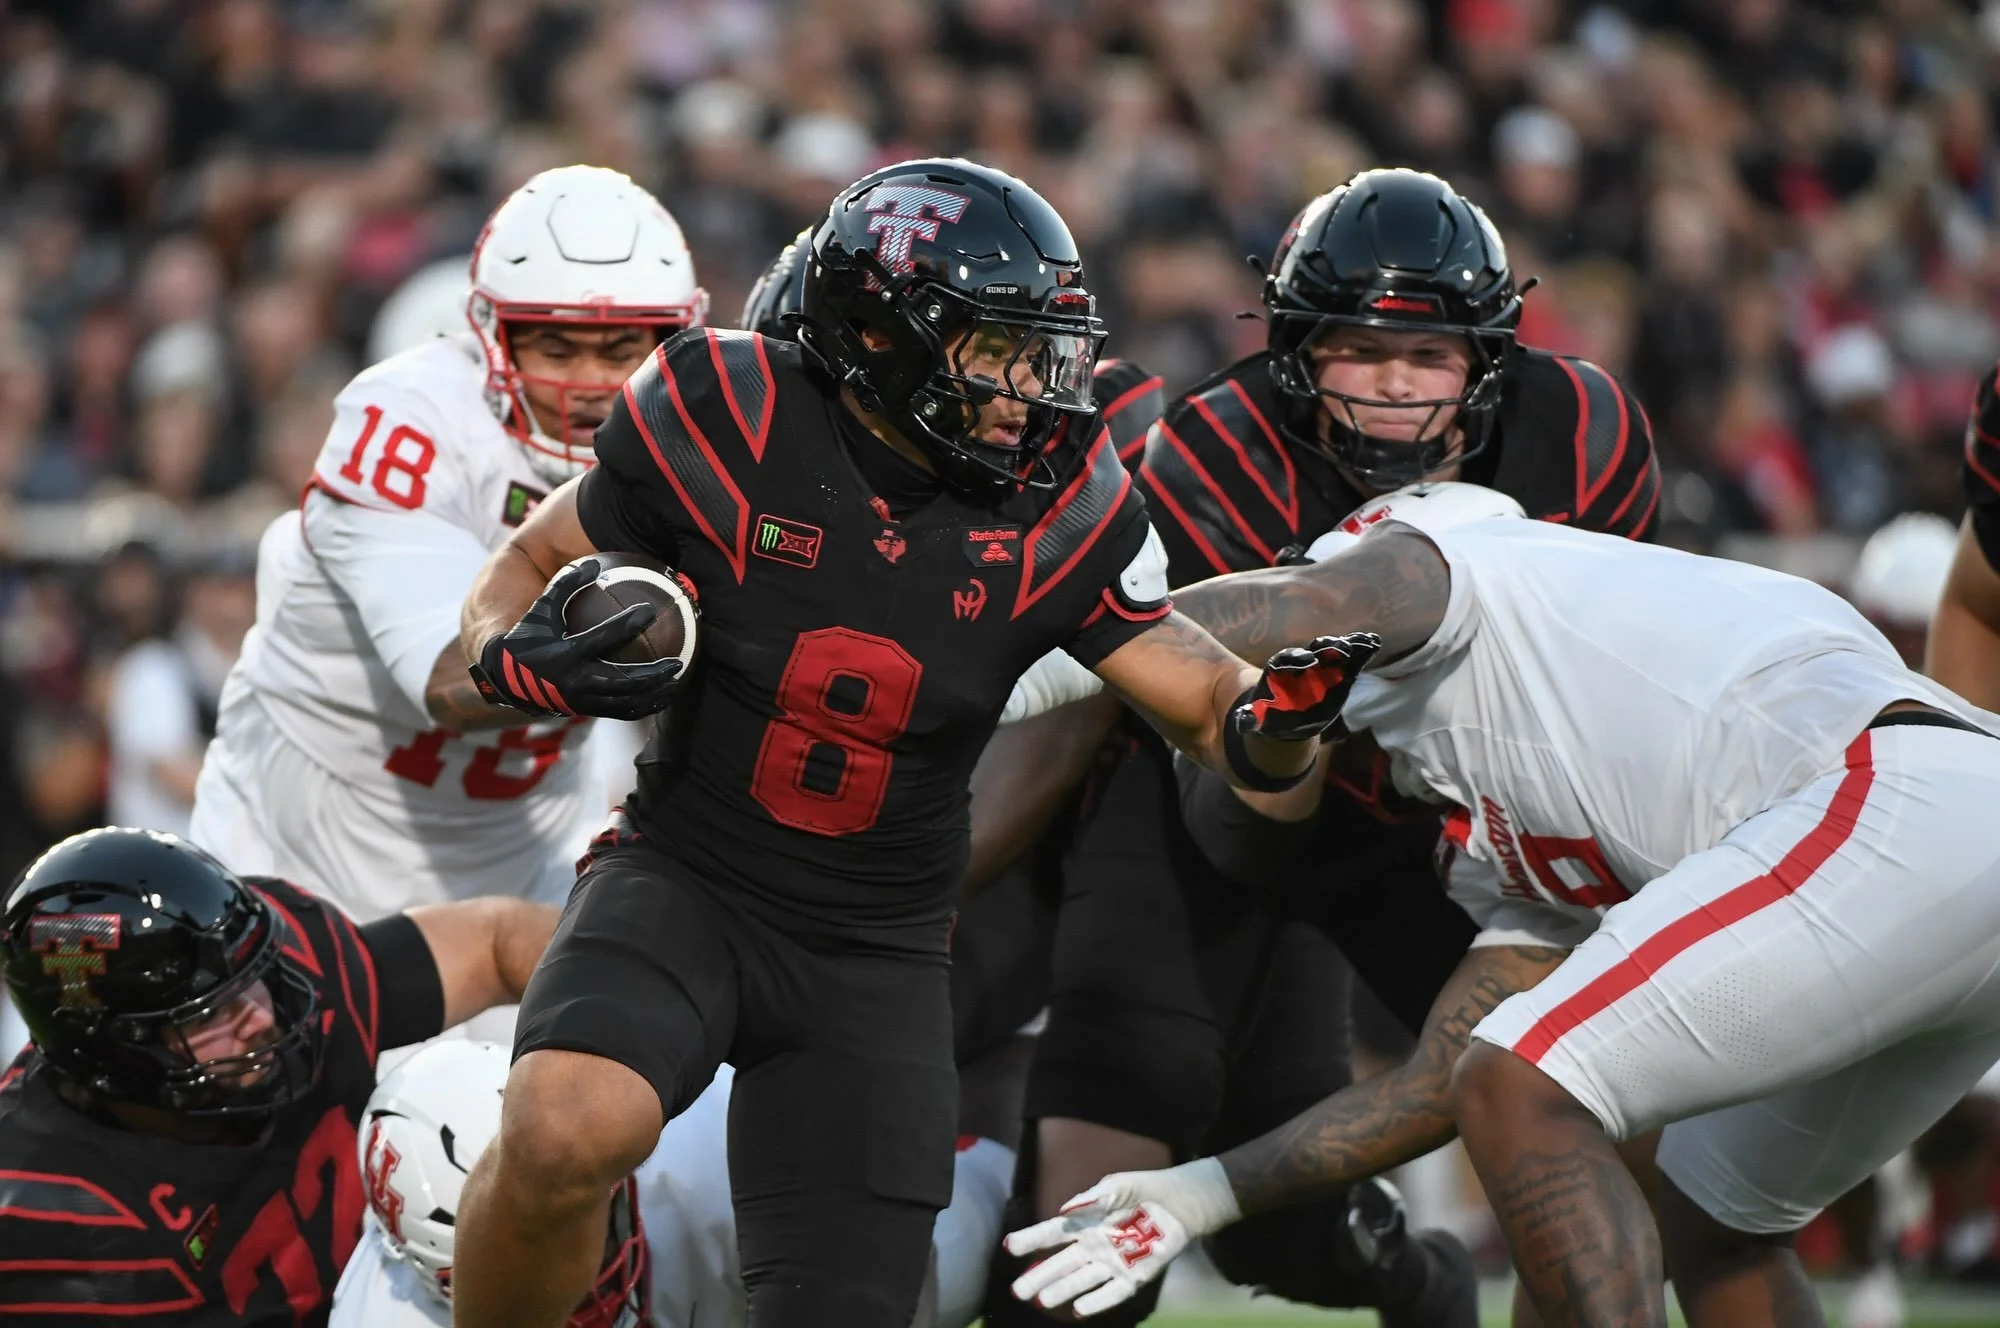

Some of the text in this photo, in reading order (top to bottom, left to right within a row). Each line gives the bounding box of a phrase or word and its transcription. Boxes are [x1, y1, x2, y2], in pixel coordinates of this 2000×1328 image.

[985, 286, 1018, 295] GUNS UP
[340, 404, 436, 510] 18
[750, 626, 923, 837] 8
[148, 1183, 193, 1231] C
